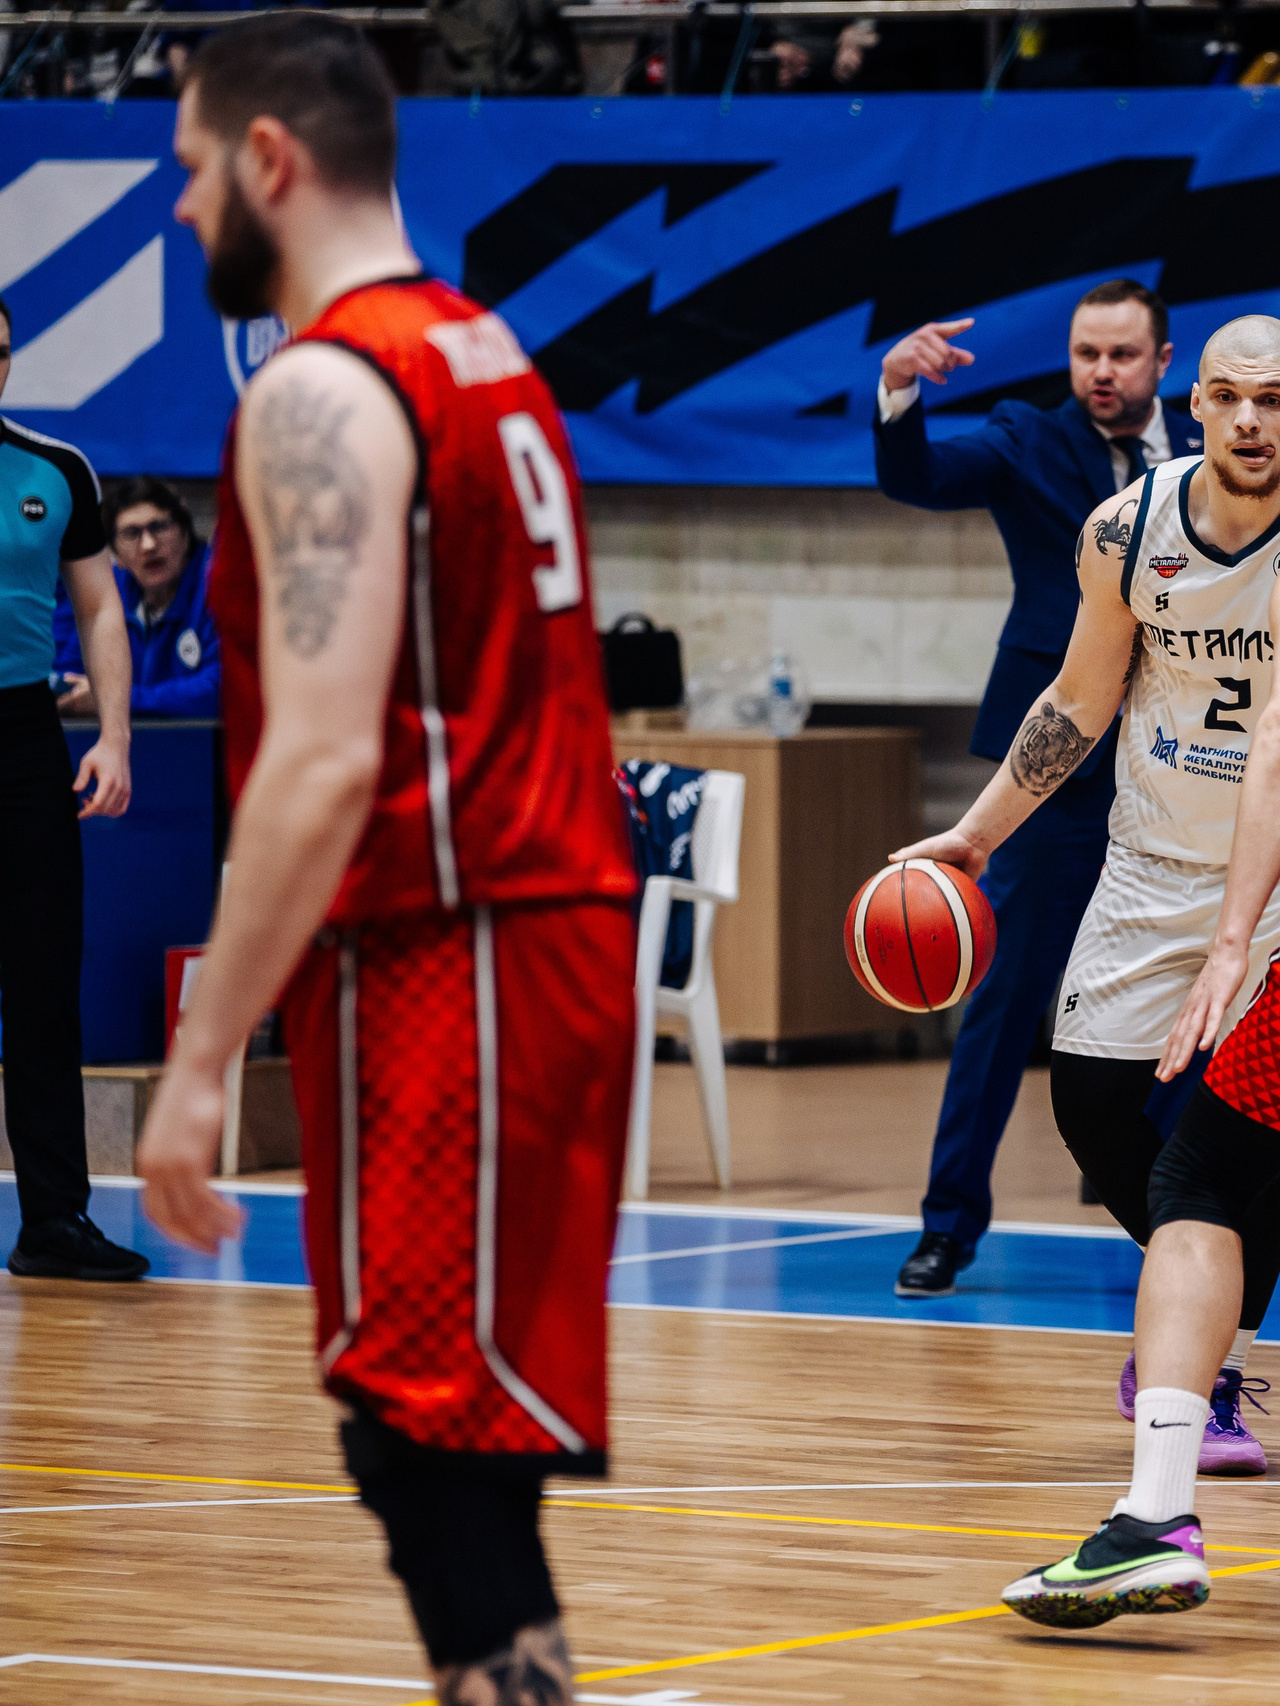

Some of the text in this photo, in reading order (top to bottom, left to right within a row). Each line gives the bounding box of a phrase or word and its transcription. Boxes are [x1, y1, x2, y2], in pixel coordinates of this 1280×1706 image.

[497, 409, 584, 615] 9
[1149, 558, 1188, 568] МЕТАЛЛУРГ
[1204, 676, 1252, 734] 2
